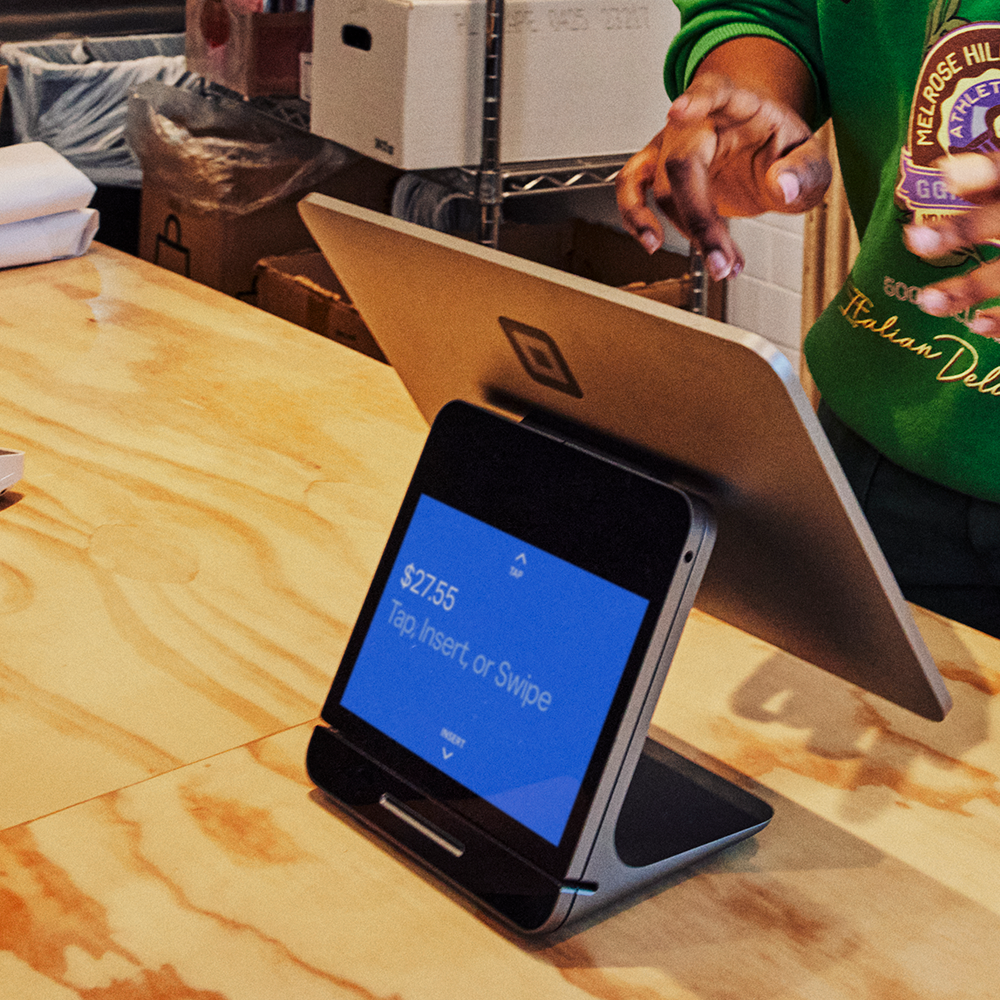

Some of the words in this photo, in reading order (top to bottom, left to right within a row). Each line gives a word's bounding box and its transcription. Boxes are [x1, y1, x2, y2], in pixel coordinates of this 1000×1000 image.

[916, 52, 963, 146] MELROSE
[839, 287, 943, 359] Italian
[401, 563, 459, 611] $27.55
[388, 599, 416, 639] Tap,
[418, 617, 470, 670] Insert,
[473, 654, 495, 677] or
[494, 661, 552, 711] Swipe
[440, 727, 466, 748] INSERT
